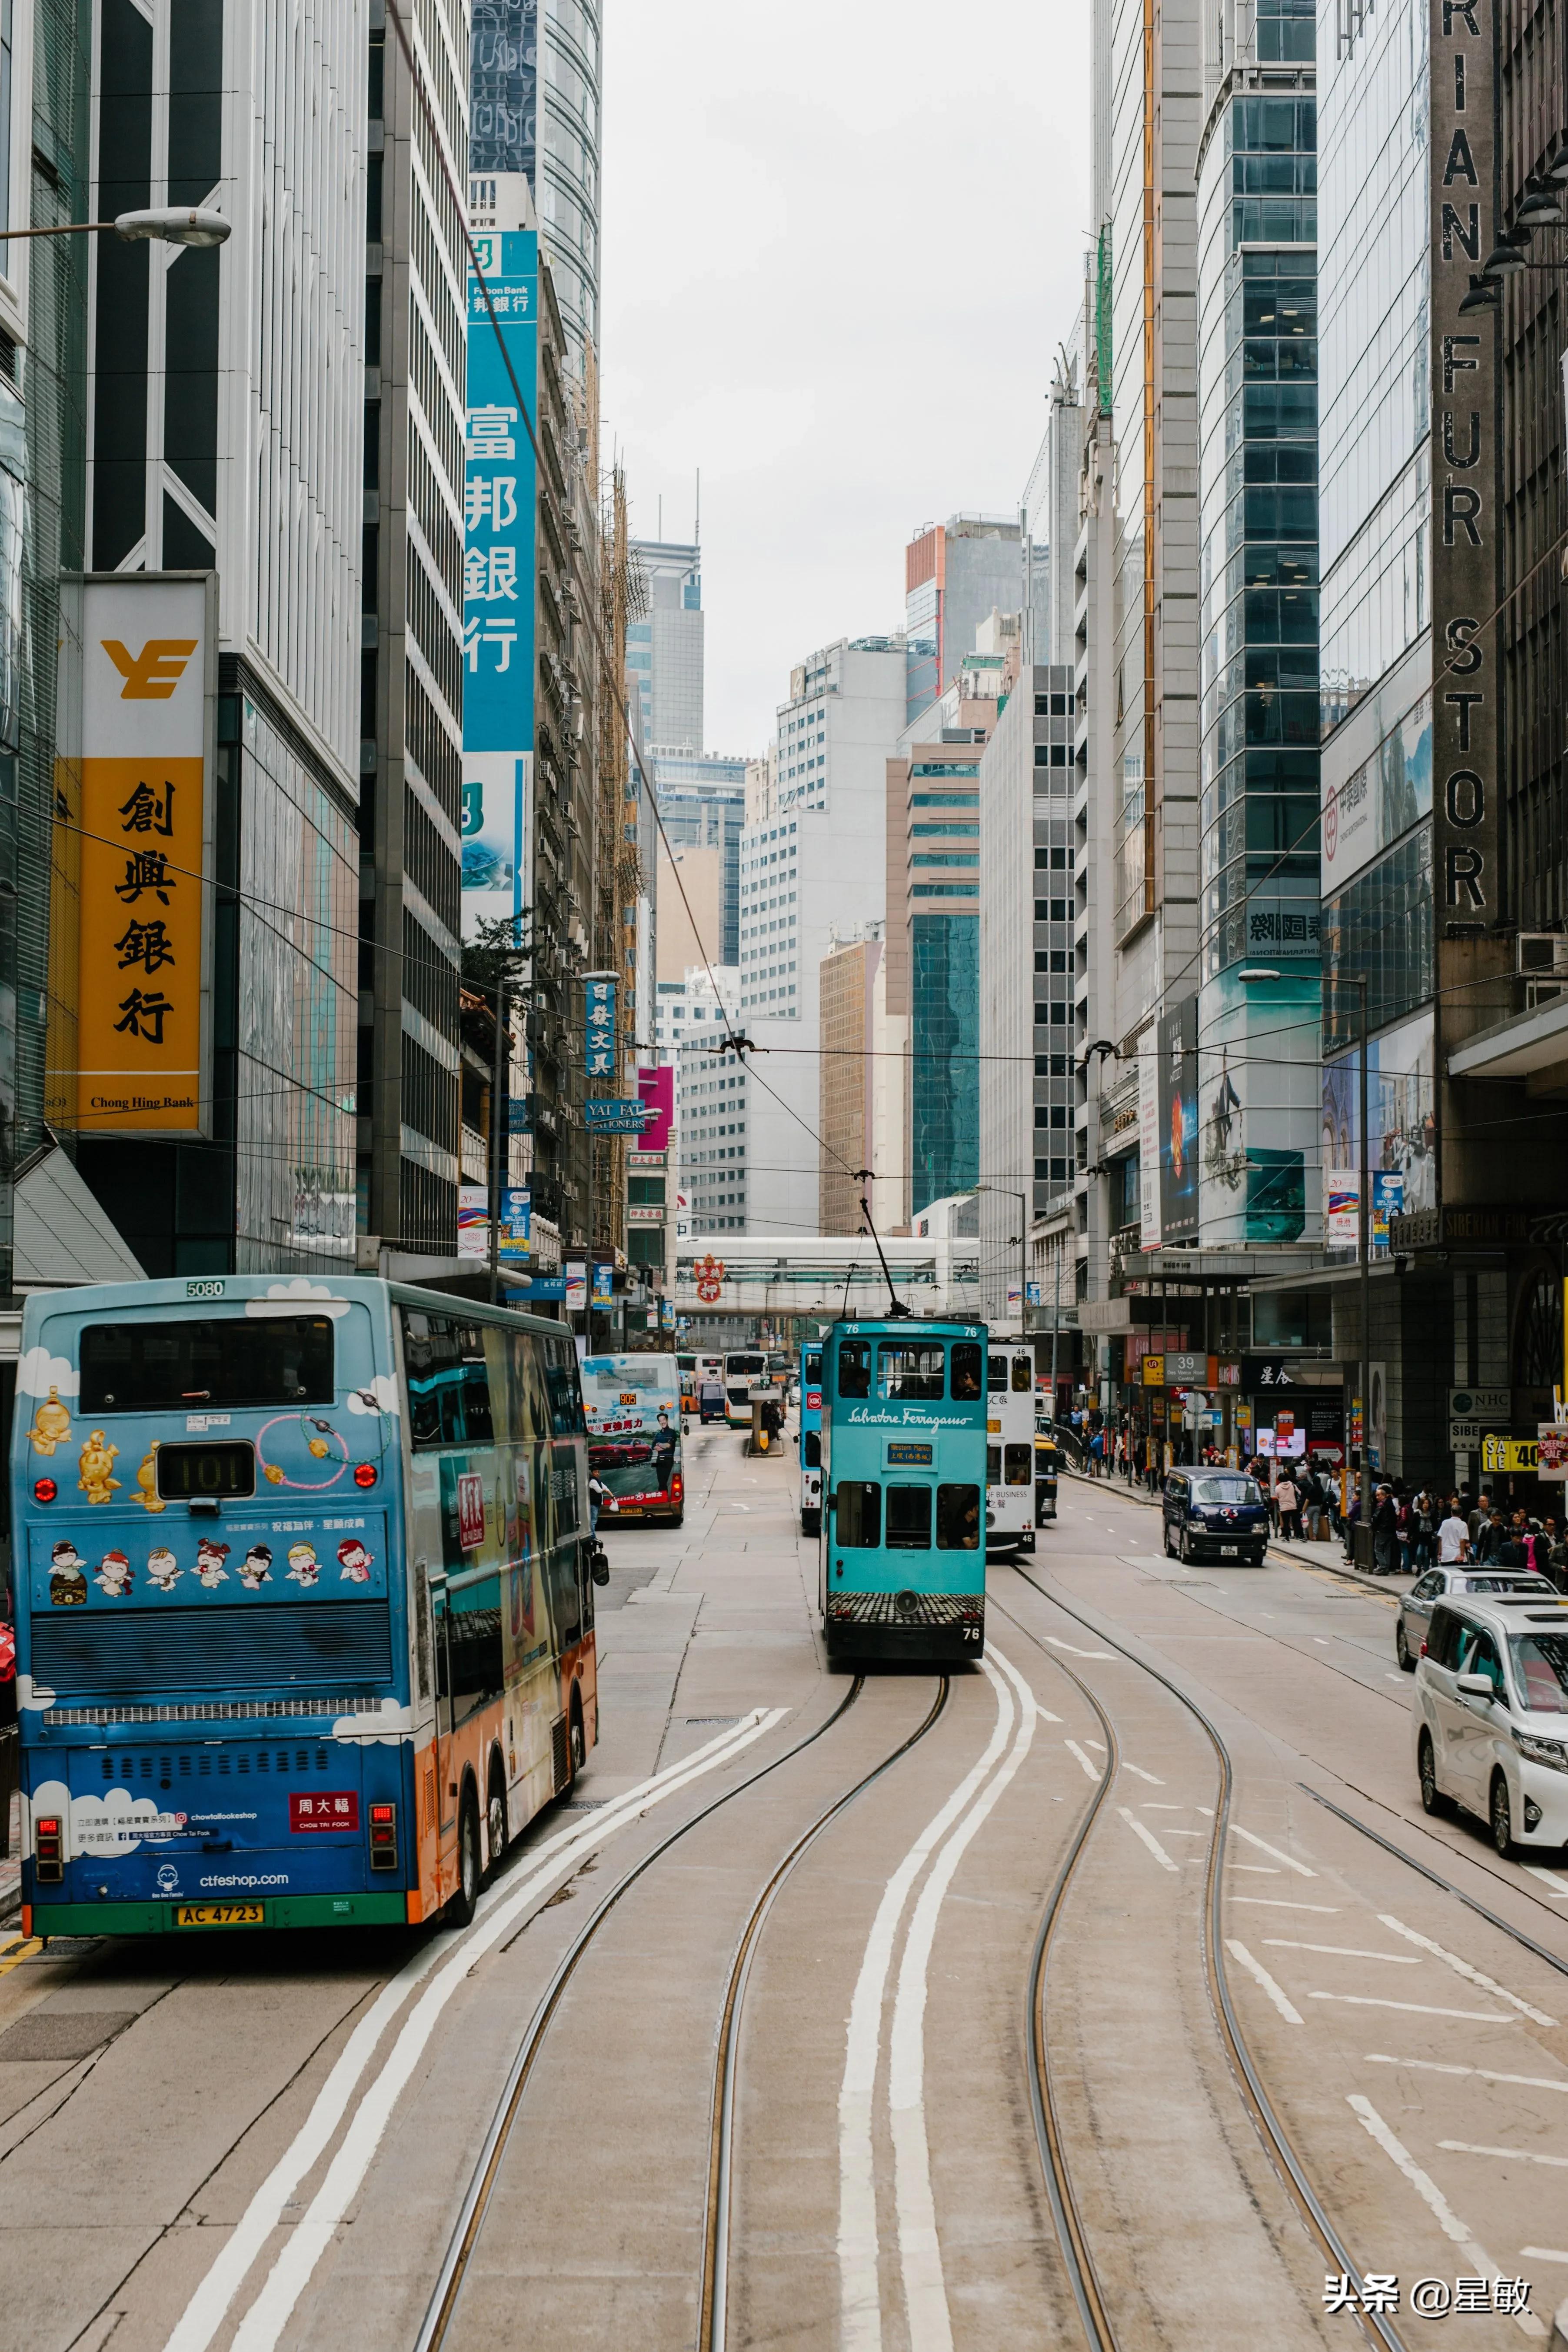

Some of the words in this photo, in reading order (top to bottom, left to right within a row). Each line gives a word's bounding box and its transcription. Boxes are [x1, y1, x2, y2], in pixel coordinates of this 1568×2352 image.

[504, 286, 528, 294] Bank
[466, 296, 529, 313] 邦銀行
[1441, 335, 1483, 546] FUR
[464, 404, 519, 673] 富邦銀行
[1443, 617, 1486, 938] STOR
[113, 780, 176, 1044] 創興銀行
[588, 983, 612, 1076] 日發文具
[90, 1097, 129, 1110] Chong
[132, 1097, 160, 1110] Hing
[163, 1097, 194, 1108] Bank
[589, 1105, 613, 1116] YAT
[619, 1105, 643, 1116] FAT
[586, 1119, 644, 1129] SATIONERS
[187, 1282, 223, 1297] 5080
[846, 1324, 859, 1333] 76
[964, 1326, 977, 1337] 76
[1178, 1356, 1194, 1369] 39
[620, 1394, 636, 1405] 905
[1475, 1394, 1508, 1406] NHC
[848, 1407, 902, 1424] Salvatore
[902, 1408, 973, 1434] Ferragamo
[1539, 1439, 1566, 1450] CHEERS!
[1544, 1450, 1562, 1459] SALE
[183, 1454, 237, 1490] 101
[962, 1628, 980, 1640] 76
[299, 1798, 349, 1814] 周大福
[191, 1812, 257, 1821] chowtaifookeshop
[77, 1832, 113, 1843] 更多資訊
[200, 1874, 289, 1887] ctfeshop.com
[184, 1909, 205, 1923] AC
[212, 1906, 259, 1922] 4723
